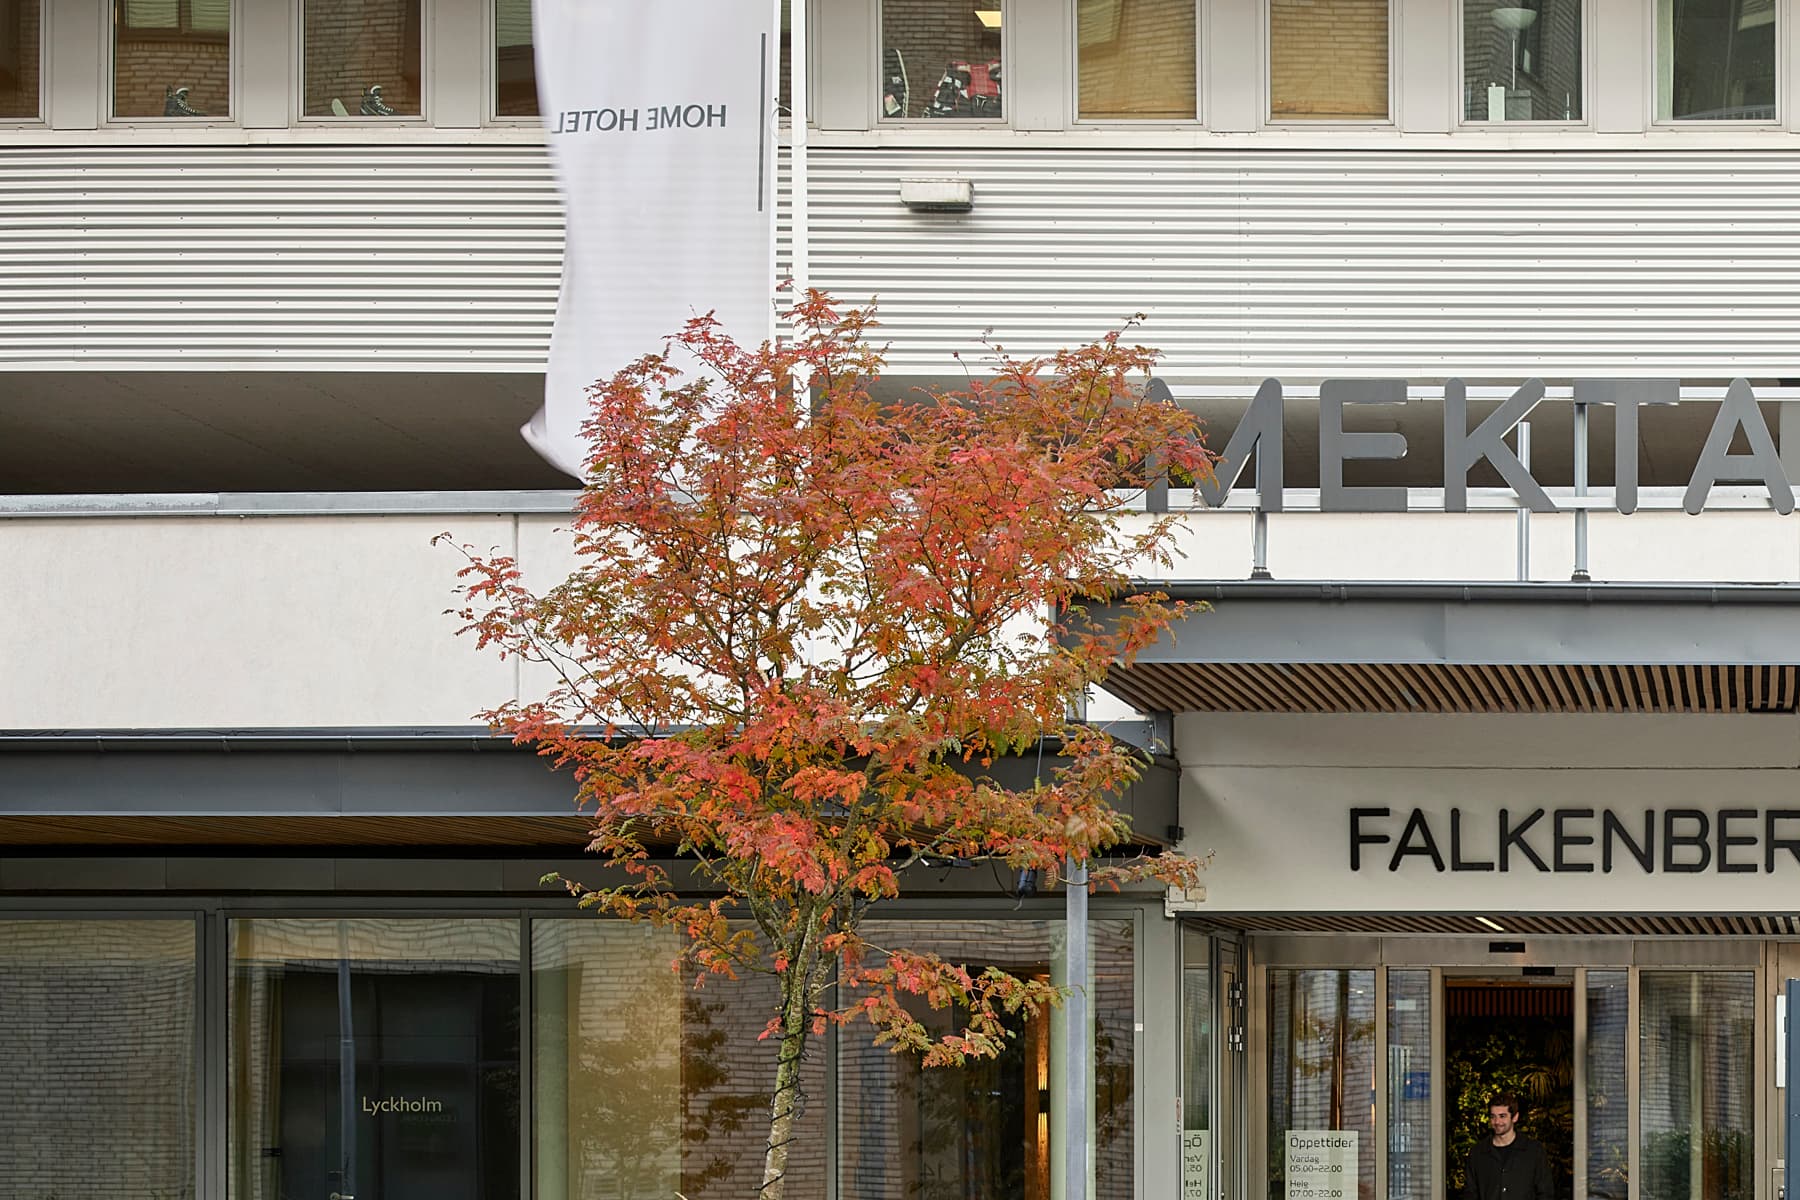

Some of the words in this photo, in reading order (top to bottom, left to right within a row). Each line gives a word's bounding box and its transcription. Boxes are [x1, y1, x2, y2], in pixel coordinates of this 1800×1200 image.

[362, 1096, 442, 1116] Lyckholm
[1290, 1134, 1354, 1150] Öppettider
[1290, 1155, 1320, 1164] Vardag
